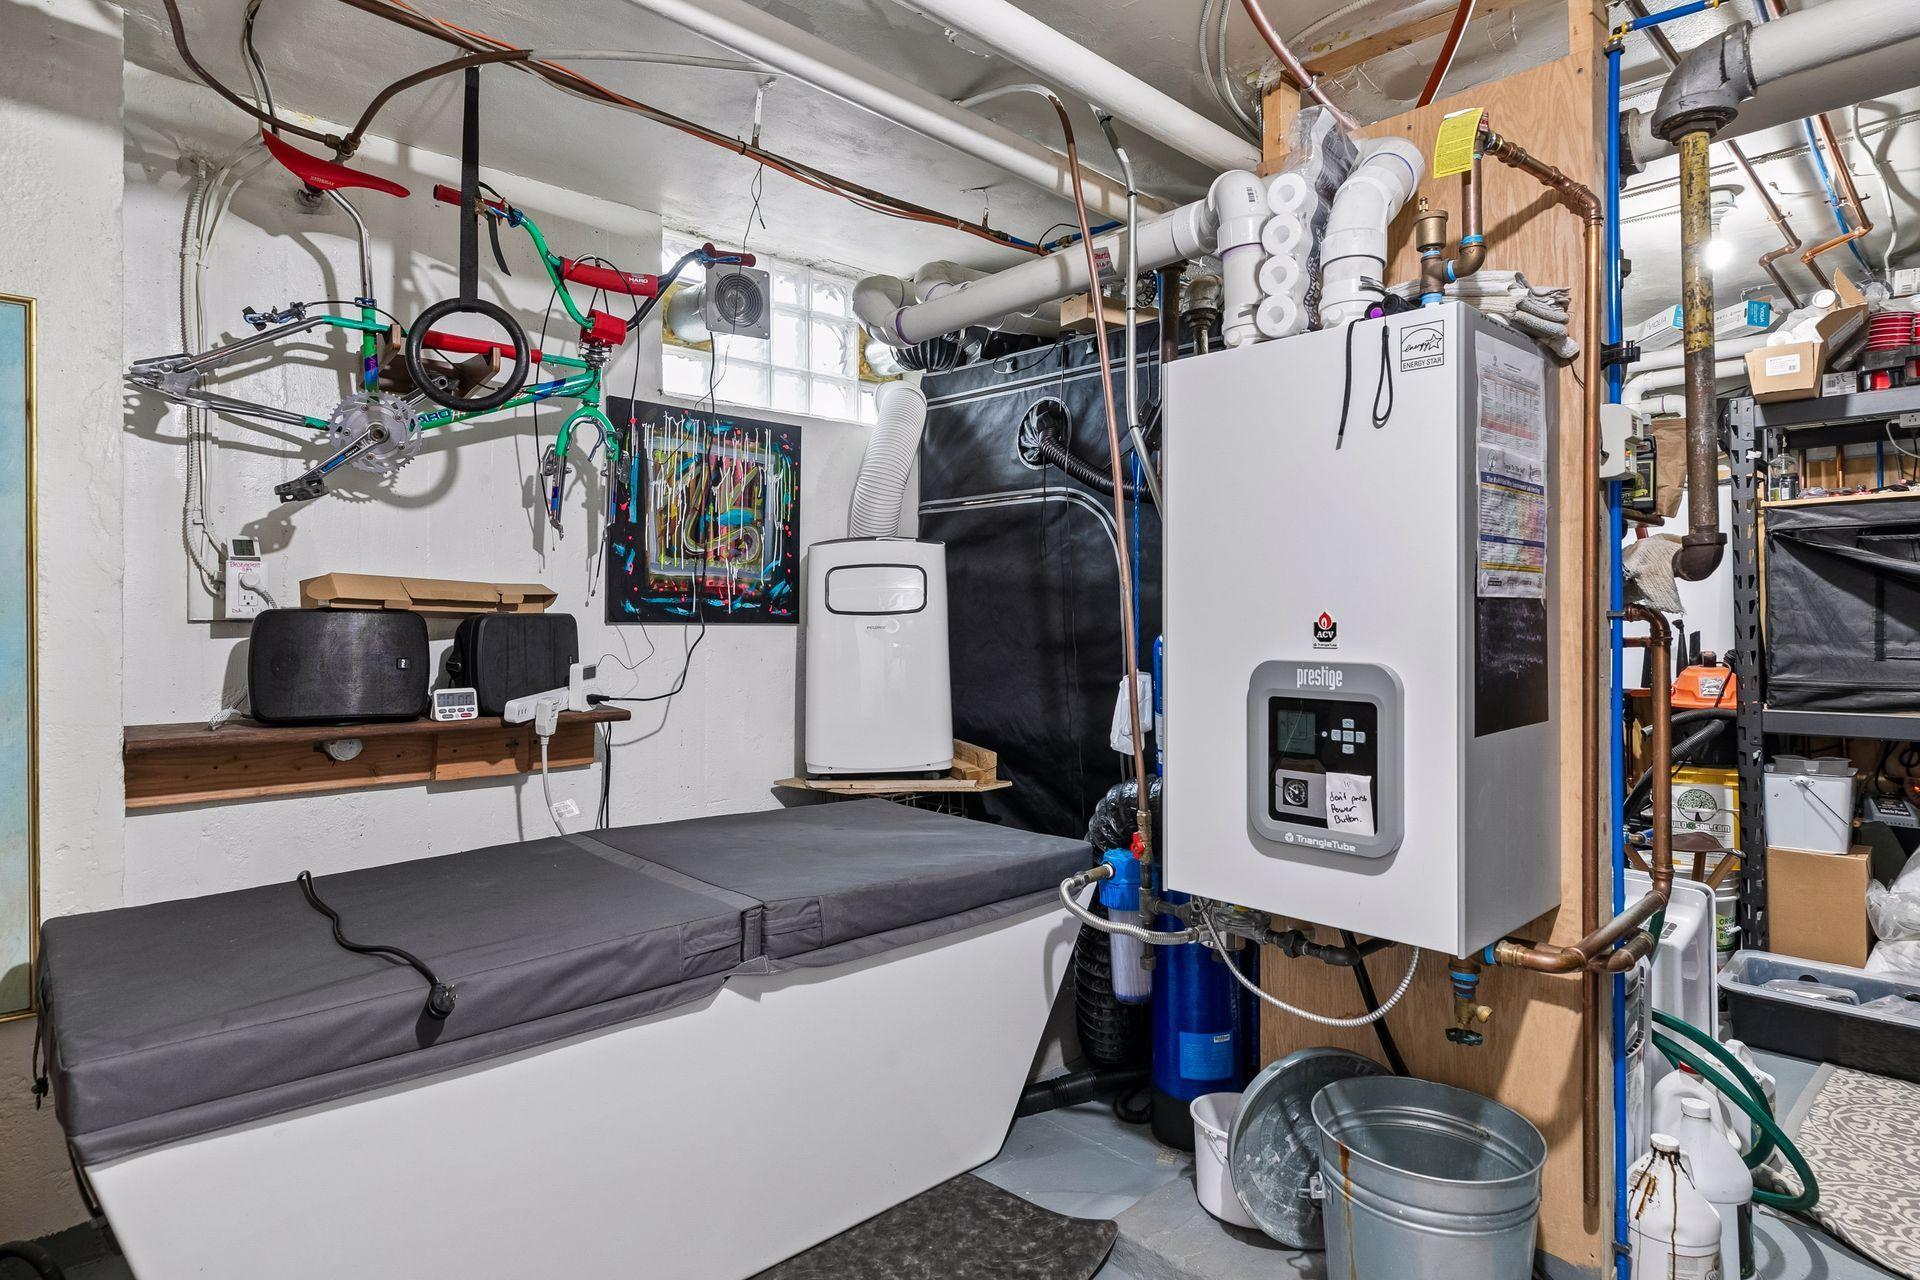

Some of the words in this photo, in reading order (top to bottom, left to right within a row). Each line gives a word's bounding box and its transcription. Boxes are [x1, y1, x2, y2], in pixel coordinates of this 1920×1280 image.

[1403, 360, 1426, 370] ENERGY
[1427, 356, 1442, 366] STAR
[1316, 630, 1335, 638] ACV
[1296, 665, 1343, 690] prestige
[1330, 803, 1357, 814] Power
[1295, 834, 1356, 852] TriangleTube
